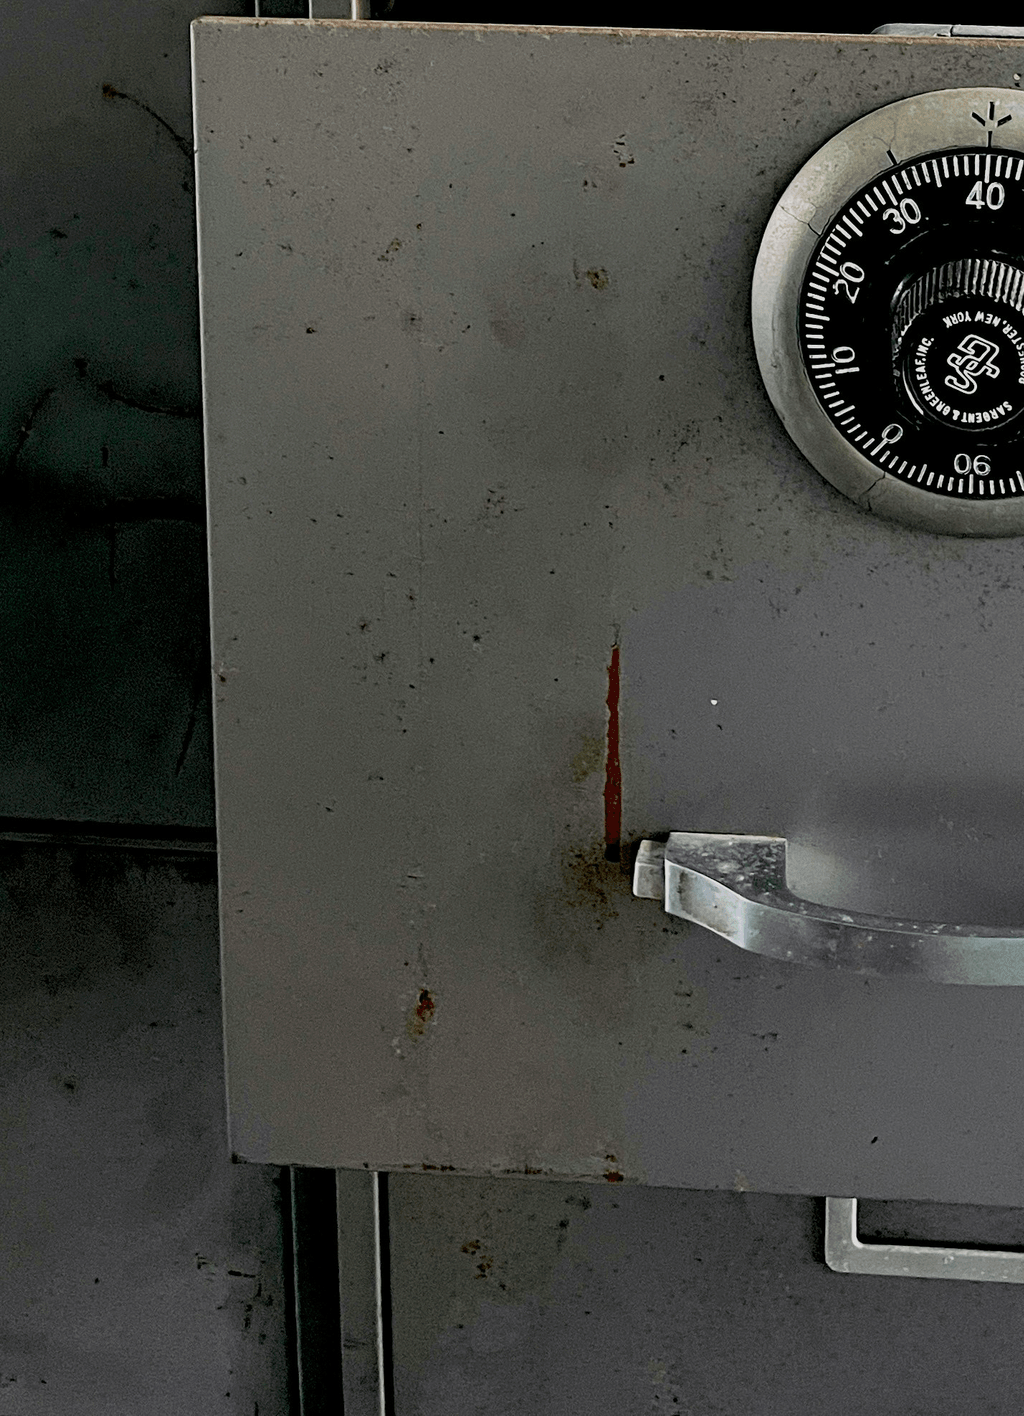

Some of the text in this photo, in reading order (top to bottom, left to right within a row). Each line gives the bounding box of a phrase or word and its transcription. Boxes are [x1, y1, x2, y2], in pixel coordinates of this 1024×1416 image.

[965, 181, 1005, 210] 40
[882, 198, 922, 235] 30
[834, 261, 865, 304] 20
[942, 310, 972, 329] YORK
[974, 310, 1001, 327] NEW
[831, 346, 859, 374] 10
[952, 409, 960, 421] &
[960, 401, 1013, 424] SARGENT
[881, 423, 903, 445] 0
[954, 453, 991, 476] 90
